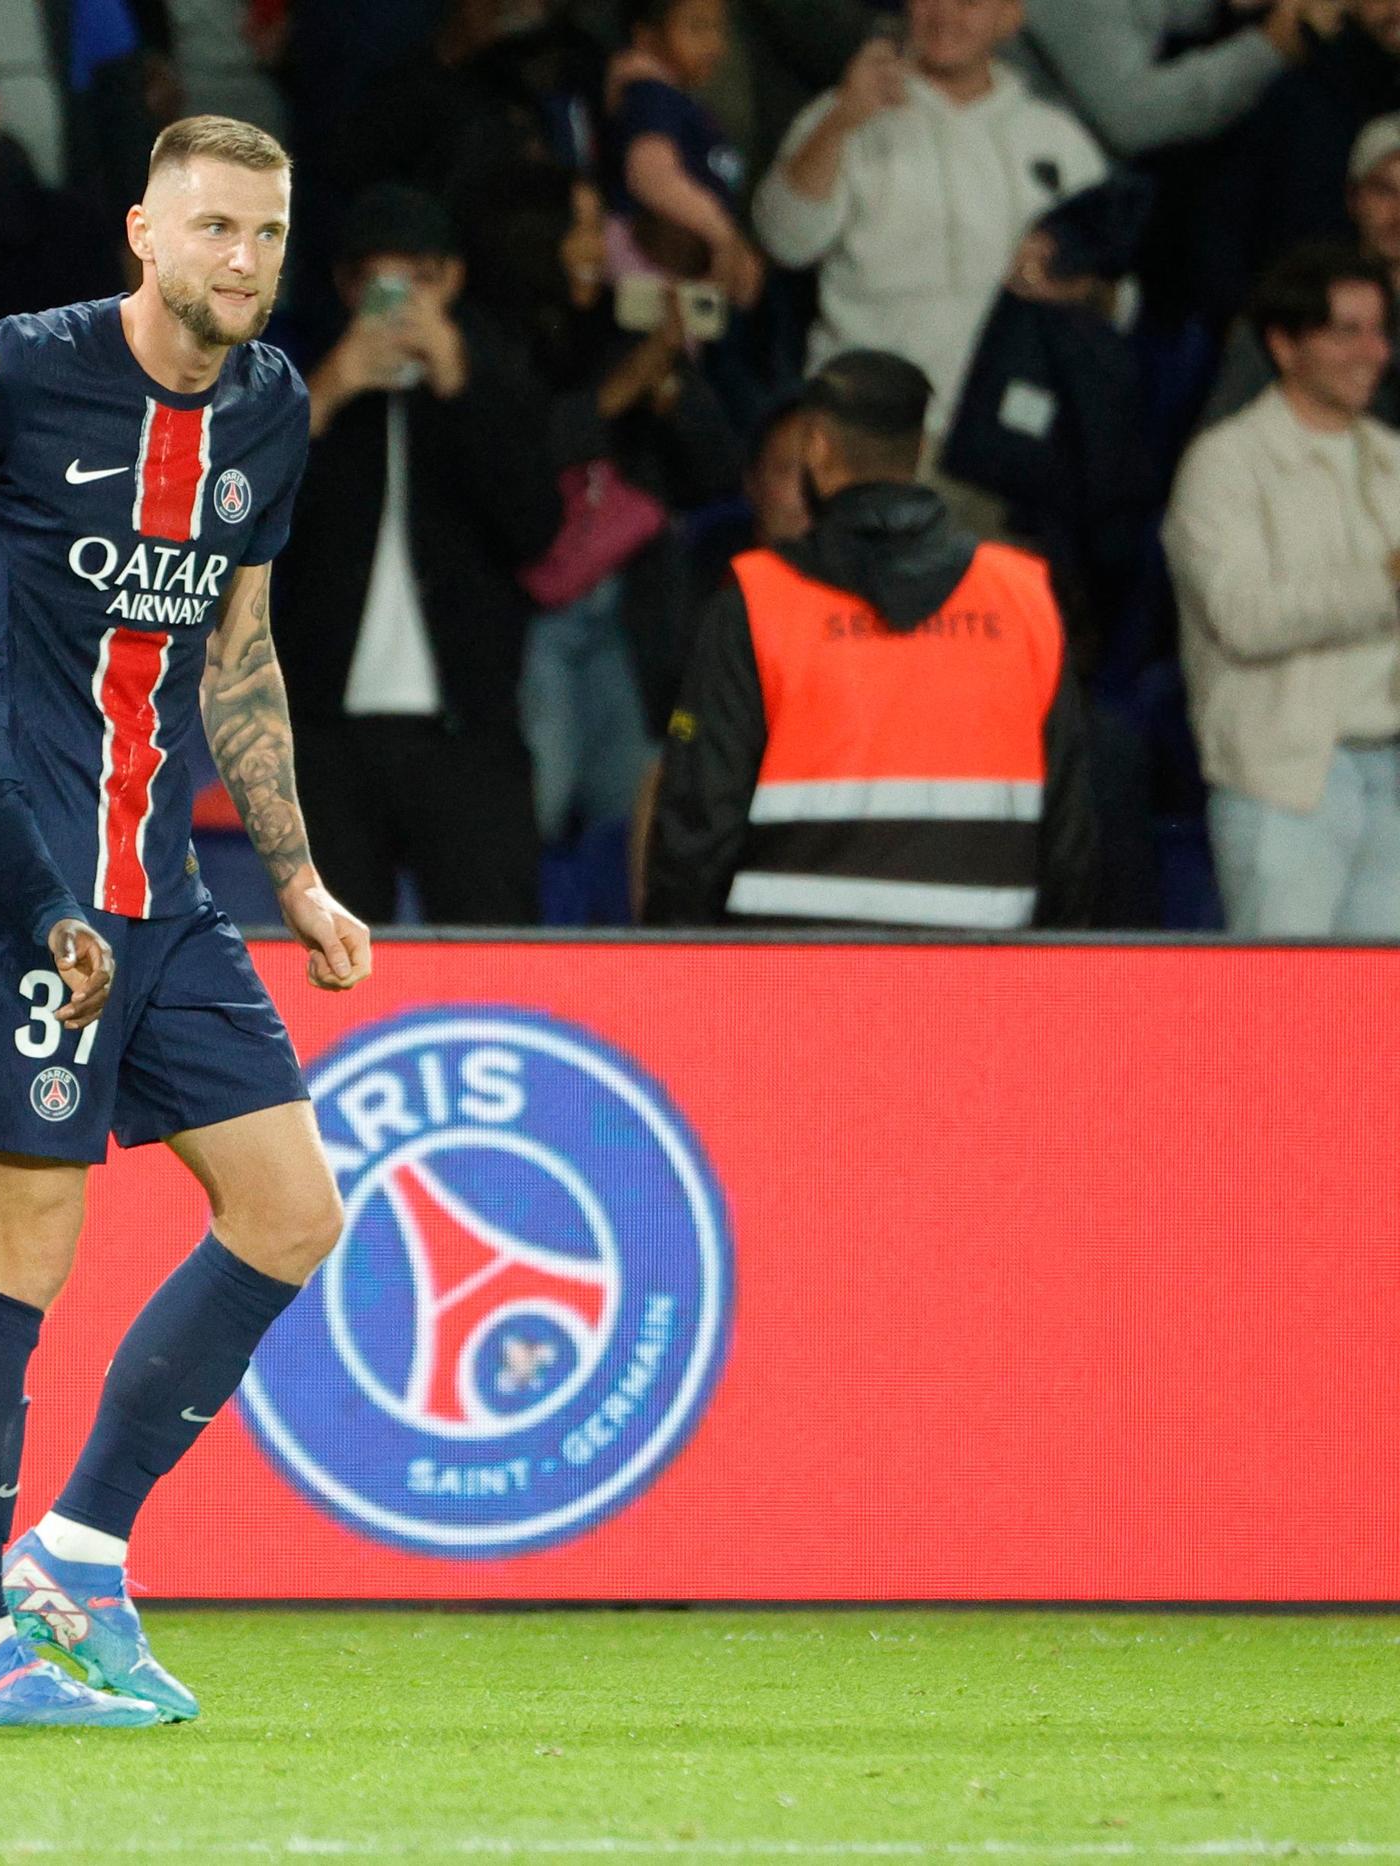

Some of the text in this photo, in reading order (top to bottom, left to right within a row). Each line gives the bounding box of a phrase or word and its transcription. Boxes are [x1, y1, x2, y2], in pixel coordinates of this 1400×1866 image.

[221, 472, 247, 487] PARIS
[68, 536, 229, 597] QATAR
[40, 1070, 72, 1083] PARIS
[324, 1047, 525, 1170] RIS
[406, 1456, 532, 1496] SAINT
